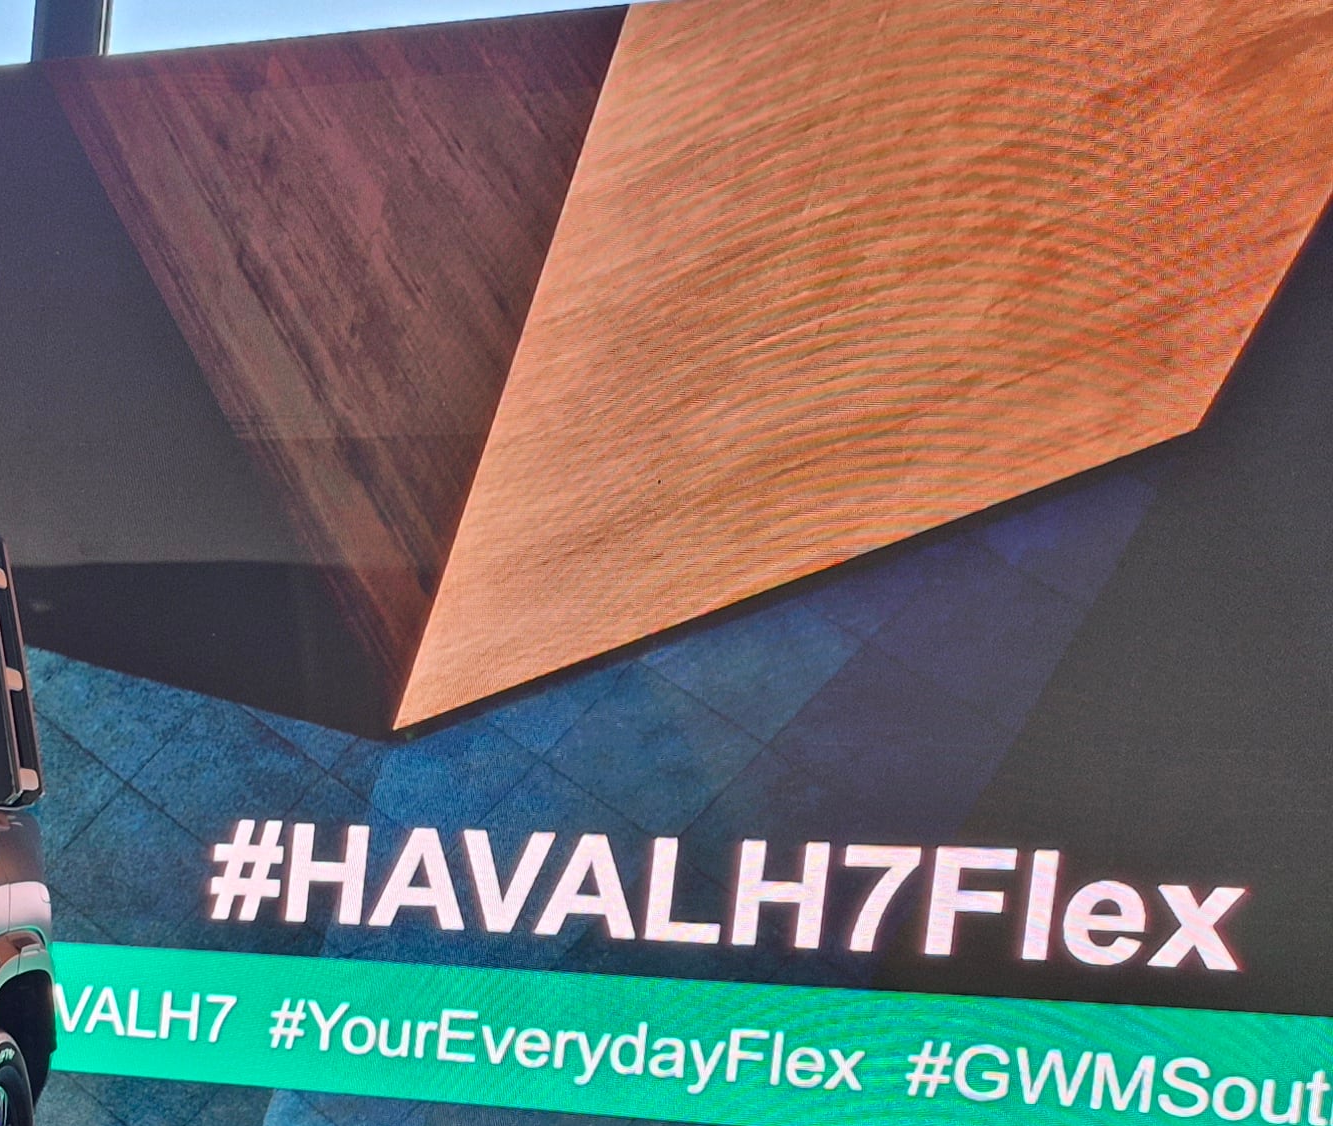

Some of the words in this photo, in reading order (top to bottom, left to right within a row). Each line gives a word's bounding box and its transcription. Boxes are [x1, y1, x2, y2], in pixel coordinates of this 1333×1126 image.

[209, 818, 1247, 972] #HAVALH7Flex
[54, 982, 238, 1044] VALH7
[268, 996, 866, 1095] #YourEverydayFlex
